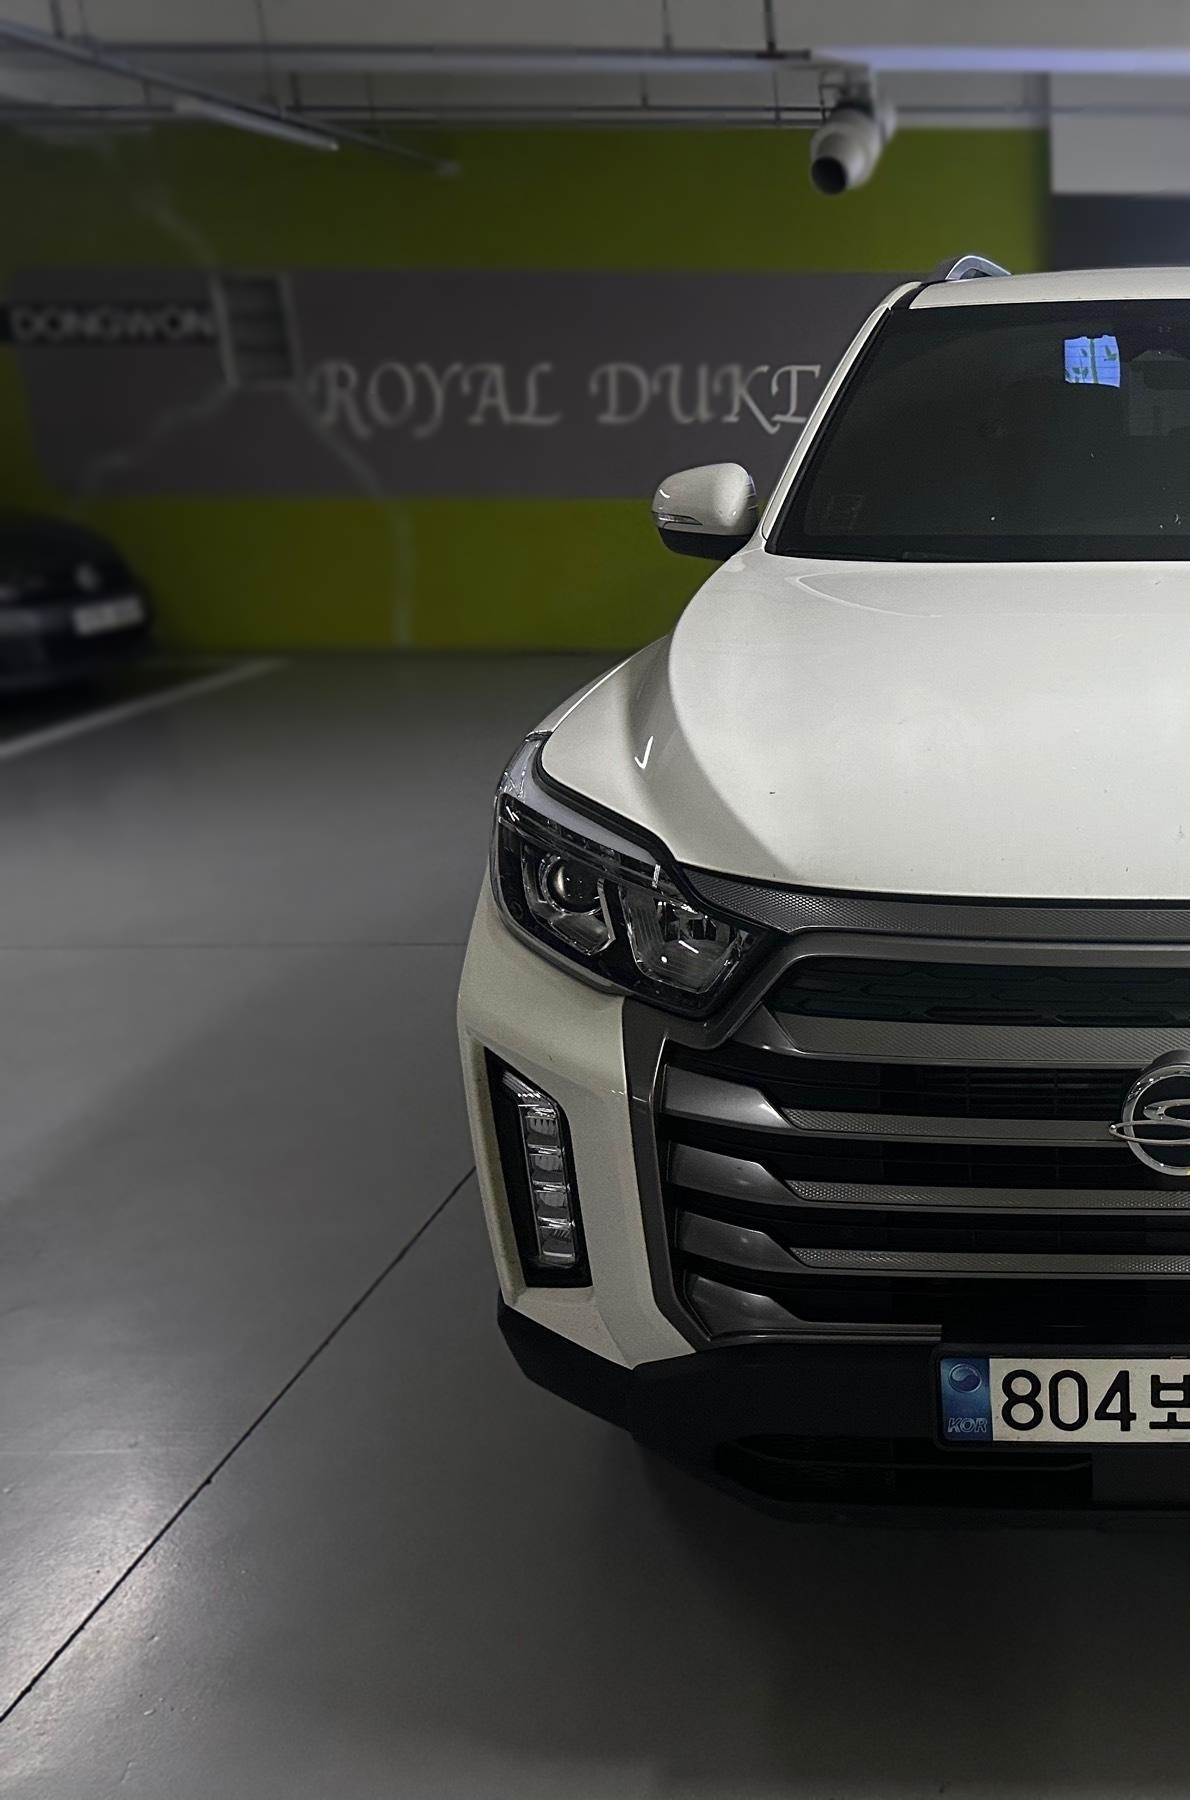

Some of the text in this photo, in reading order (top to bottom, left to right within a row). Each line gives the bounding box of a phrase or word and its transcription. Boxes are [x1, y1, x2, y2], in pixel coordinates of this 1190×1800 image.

[9, 306, 216, 342] DONGWON
[306, 359, 561, 439] ROYAL
[947, 1417, 987, 1433] KOR
